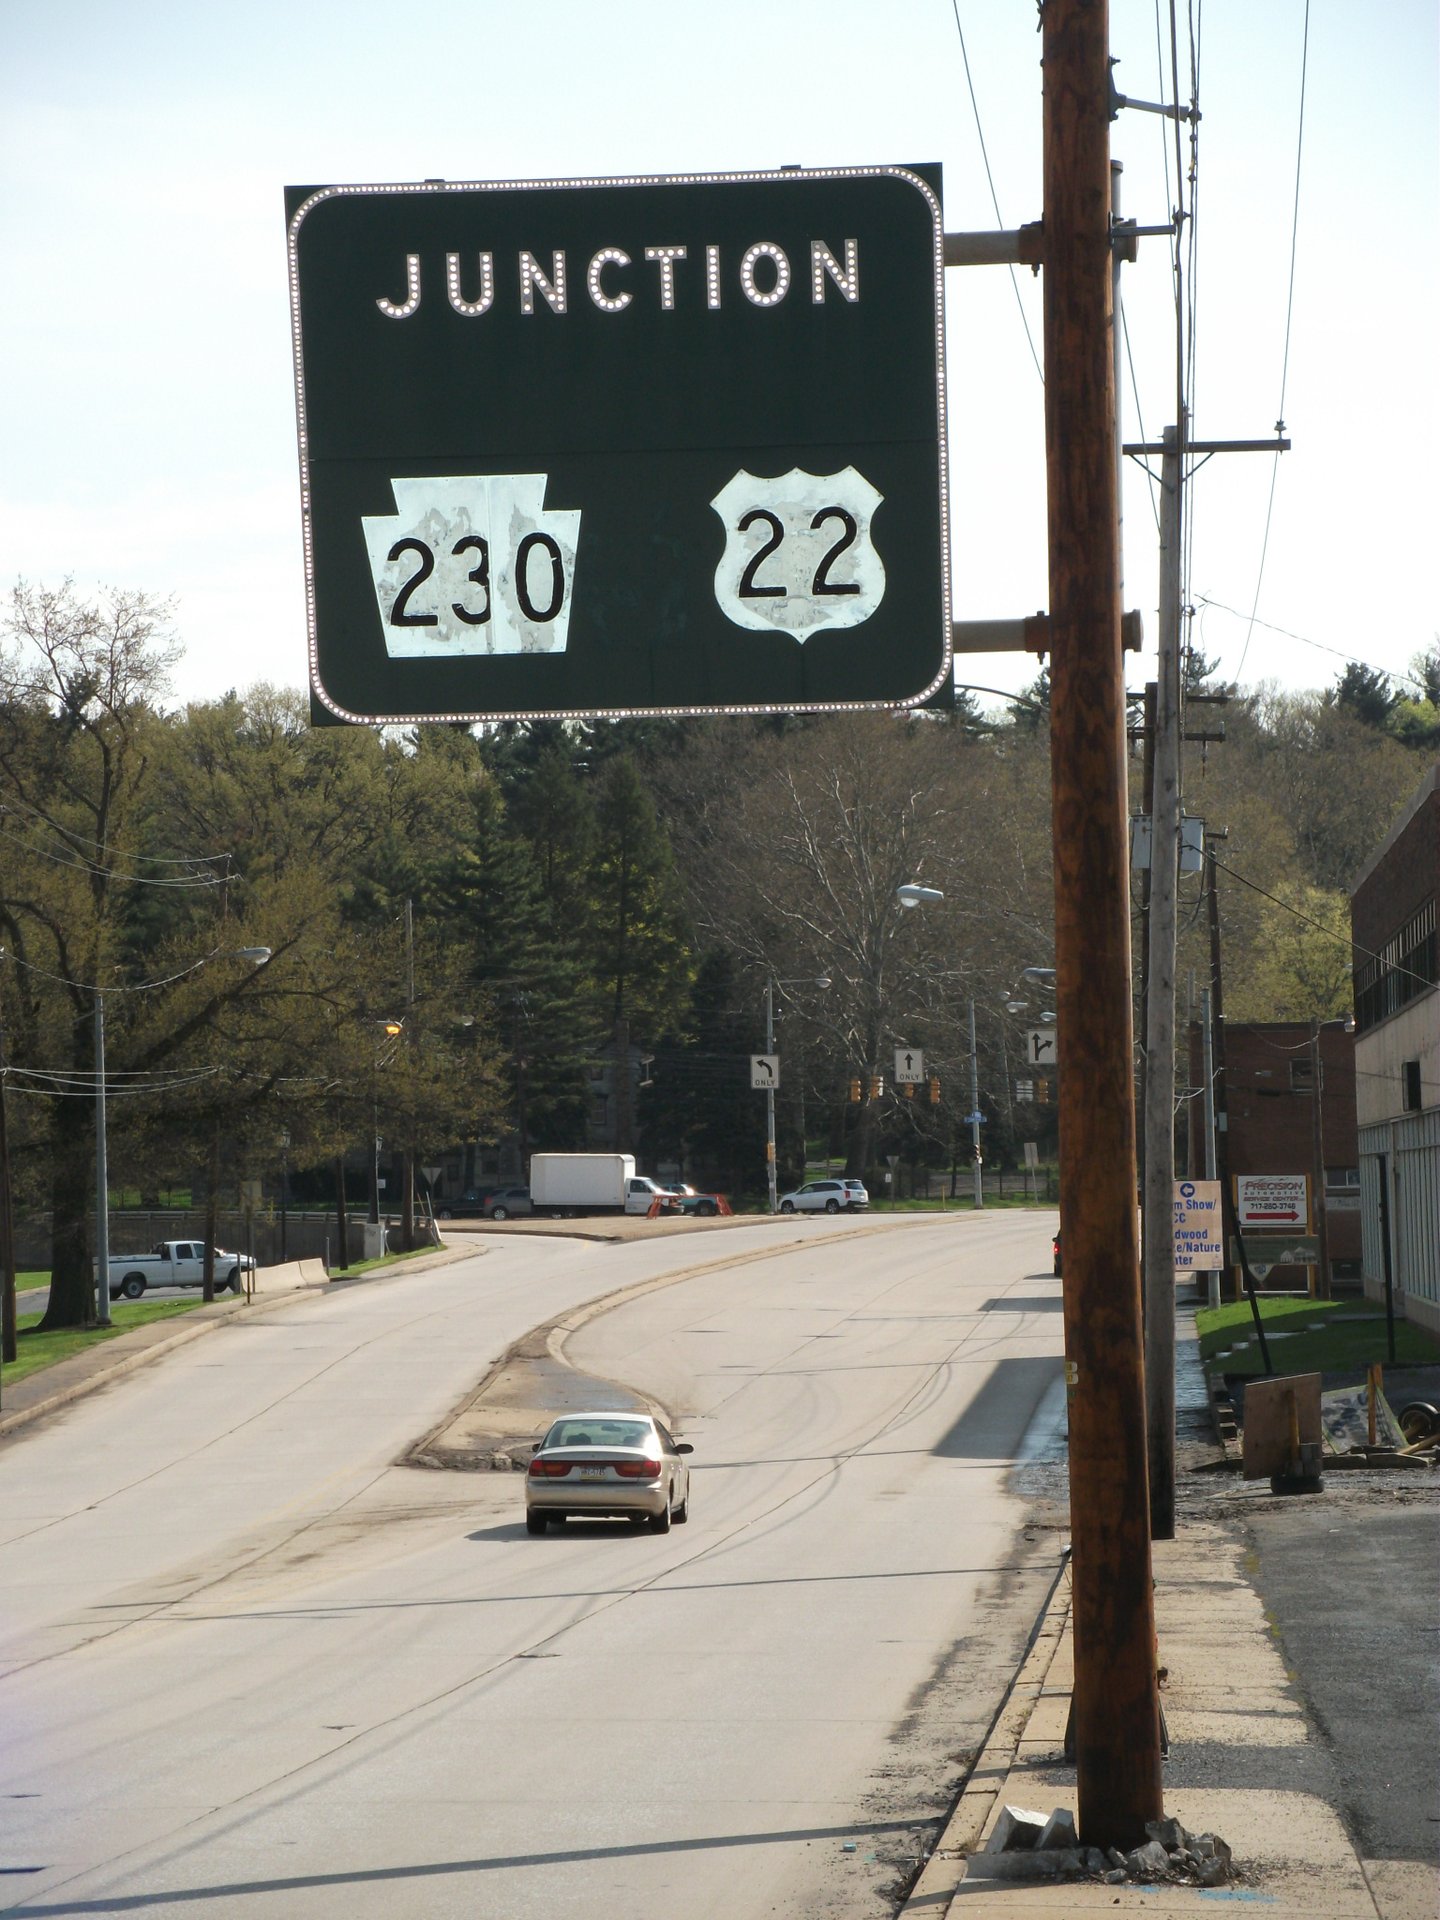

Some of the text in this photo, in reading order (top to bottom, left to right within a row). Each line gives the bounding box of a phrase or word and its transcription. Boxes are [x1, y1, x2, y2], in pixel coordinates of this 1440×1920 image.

[375, 238, 859, 319] JUNCTION
[736, 506, 861, 598] 22
[386, 531, 565, 627] 230
[755, 1079, 775, 1087] ONLY
[899, 1073, 920, 1081] ONLY
[1245, 1181, 1303, 1191] PRECISION
